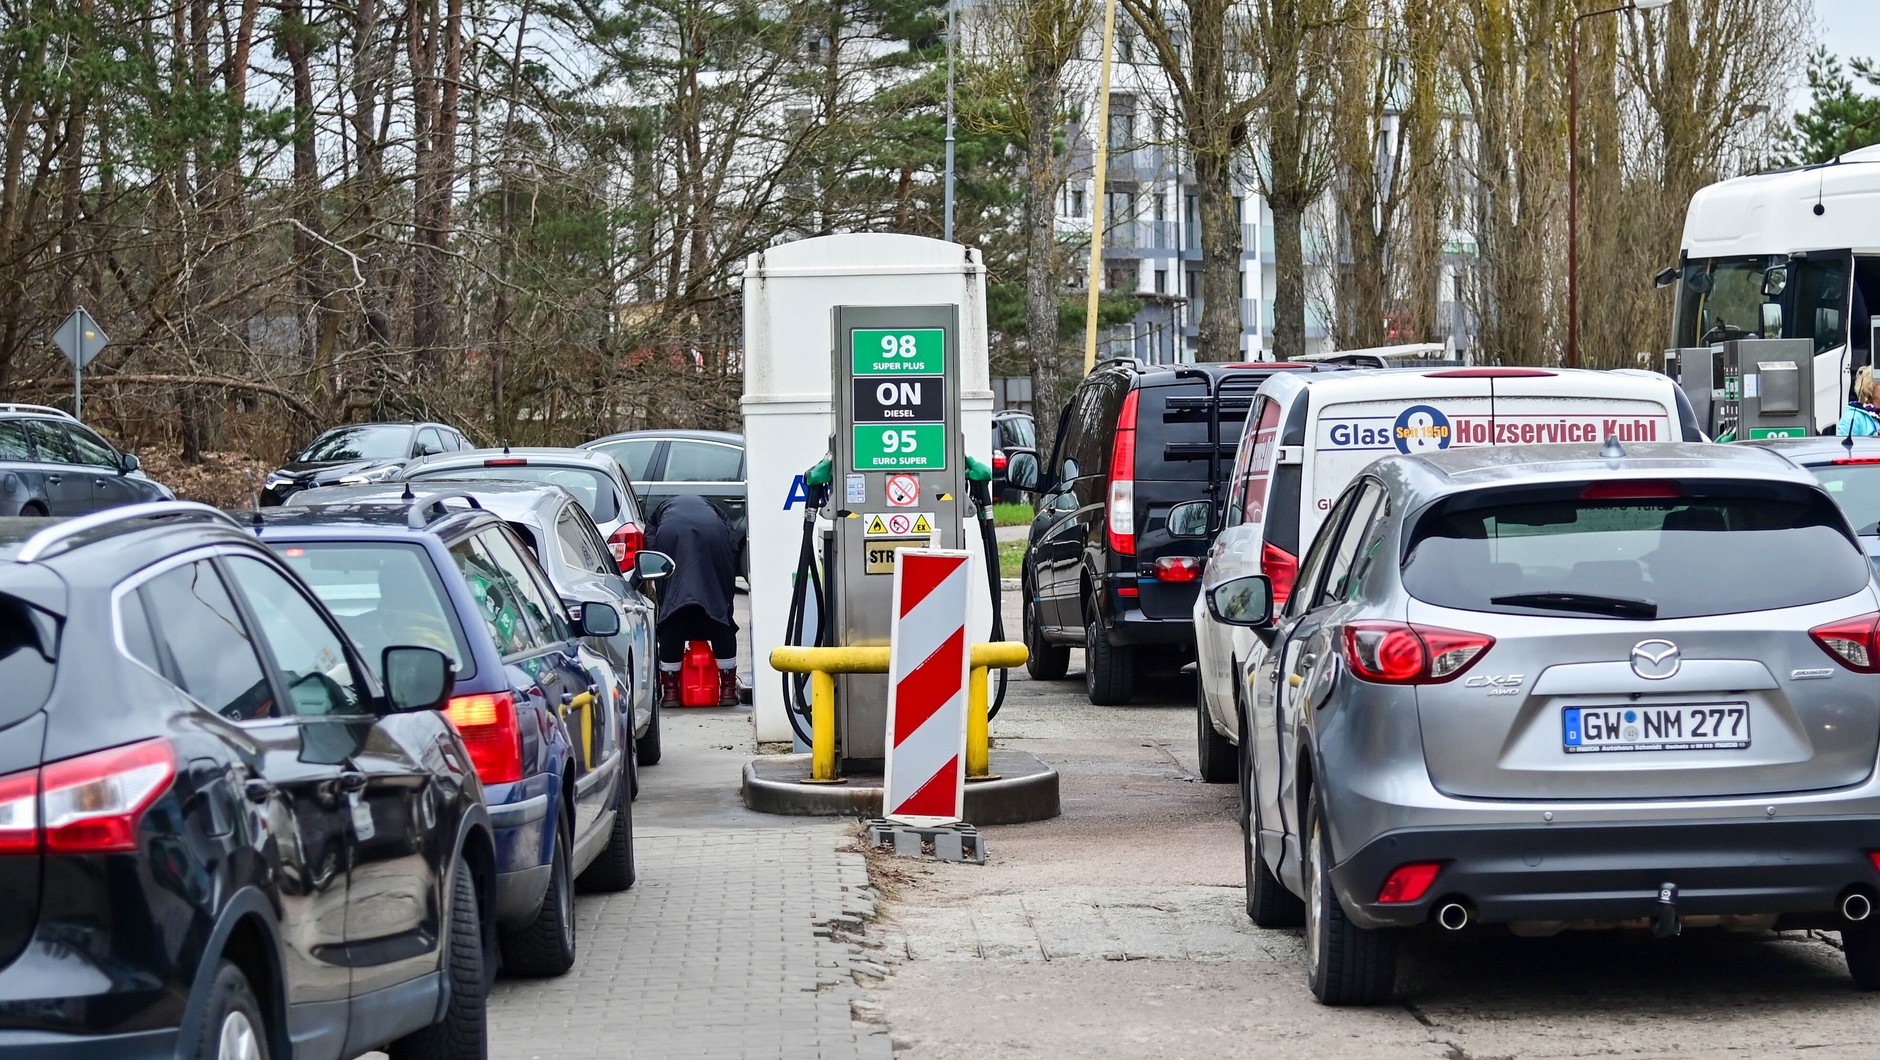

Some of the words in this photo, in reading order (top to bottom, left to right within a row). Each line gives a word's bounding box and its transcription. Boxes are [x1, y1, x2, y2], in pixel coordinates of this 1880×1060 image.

[880, 335, 917, 358] 98
[873, 362, 901, 370] SUPER
[903, 362, 925, 370] PLUS
[876, 382, 922, 406] ON
[884, 410, 915, 418] DIESEL
[1330, 423, 1390, 446] Glas
[1456, 419, 1597, 443] Holzservice
[1603, 419, 1656, 442] Kuhl
[1396, 426, 1419, 439] Seit
[1421, 425, 1449, 438] 1950
[881, 430, 917, 453] 95
[873, 457, 898, 465] EURO
[899, 456, 927, 465] SUPER
[1464, 674, 1524, 688] CX-5
[1487, 688, 1520, 697] AWD
[1583, 712, 1622, 740] GW
[1643, 710, 1683, 739] NM
[1690, 709, 1745, 738] 277
[1569, 731, 1577, 740] D
